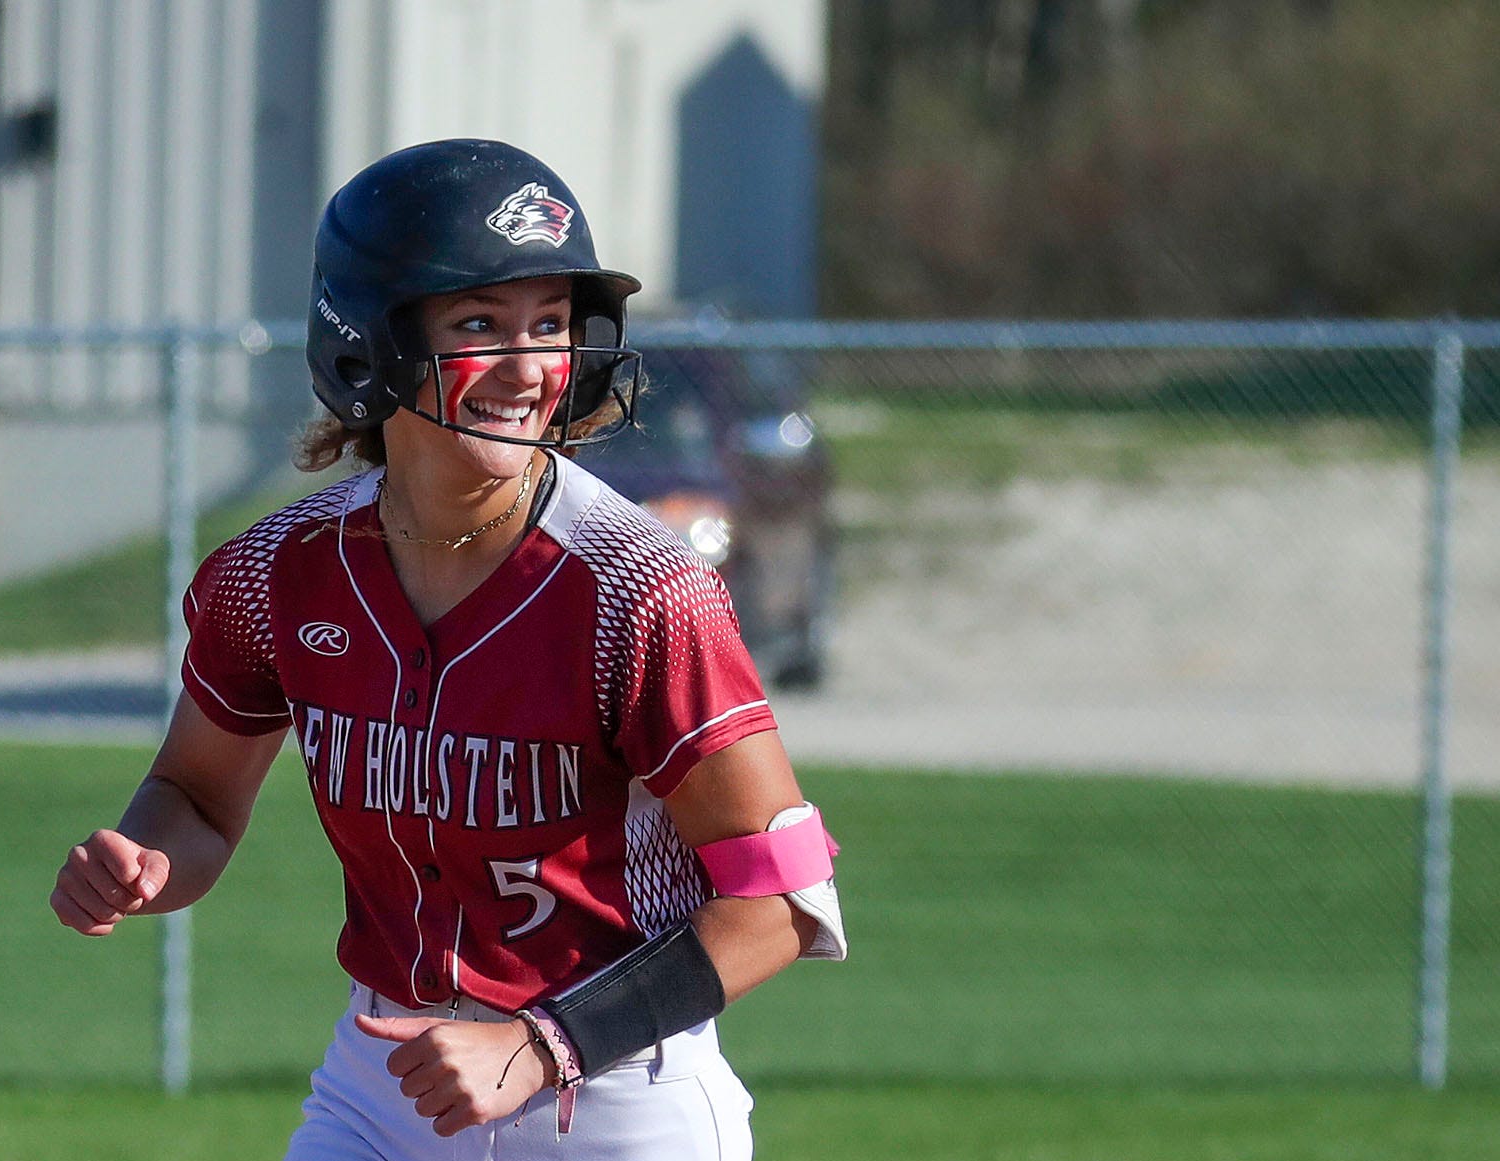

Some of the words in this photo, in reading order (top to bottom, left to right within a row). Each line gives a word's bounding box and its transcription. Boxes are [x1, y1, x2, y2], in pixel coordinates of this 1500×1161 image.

[317, 298, 361, 342] RIP-IT
[288, 702, 353, 805] EW
[363, 719, 582, 828] HOLSTEIN
[487, 857, 556, 938] 5
